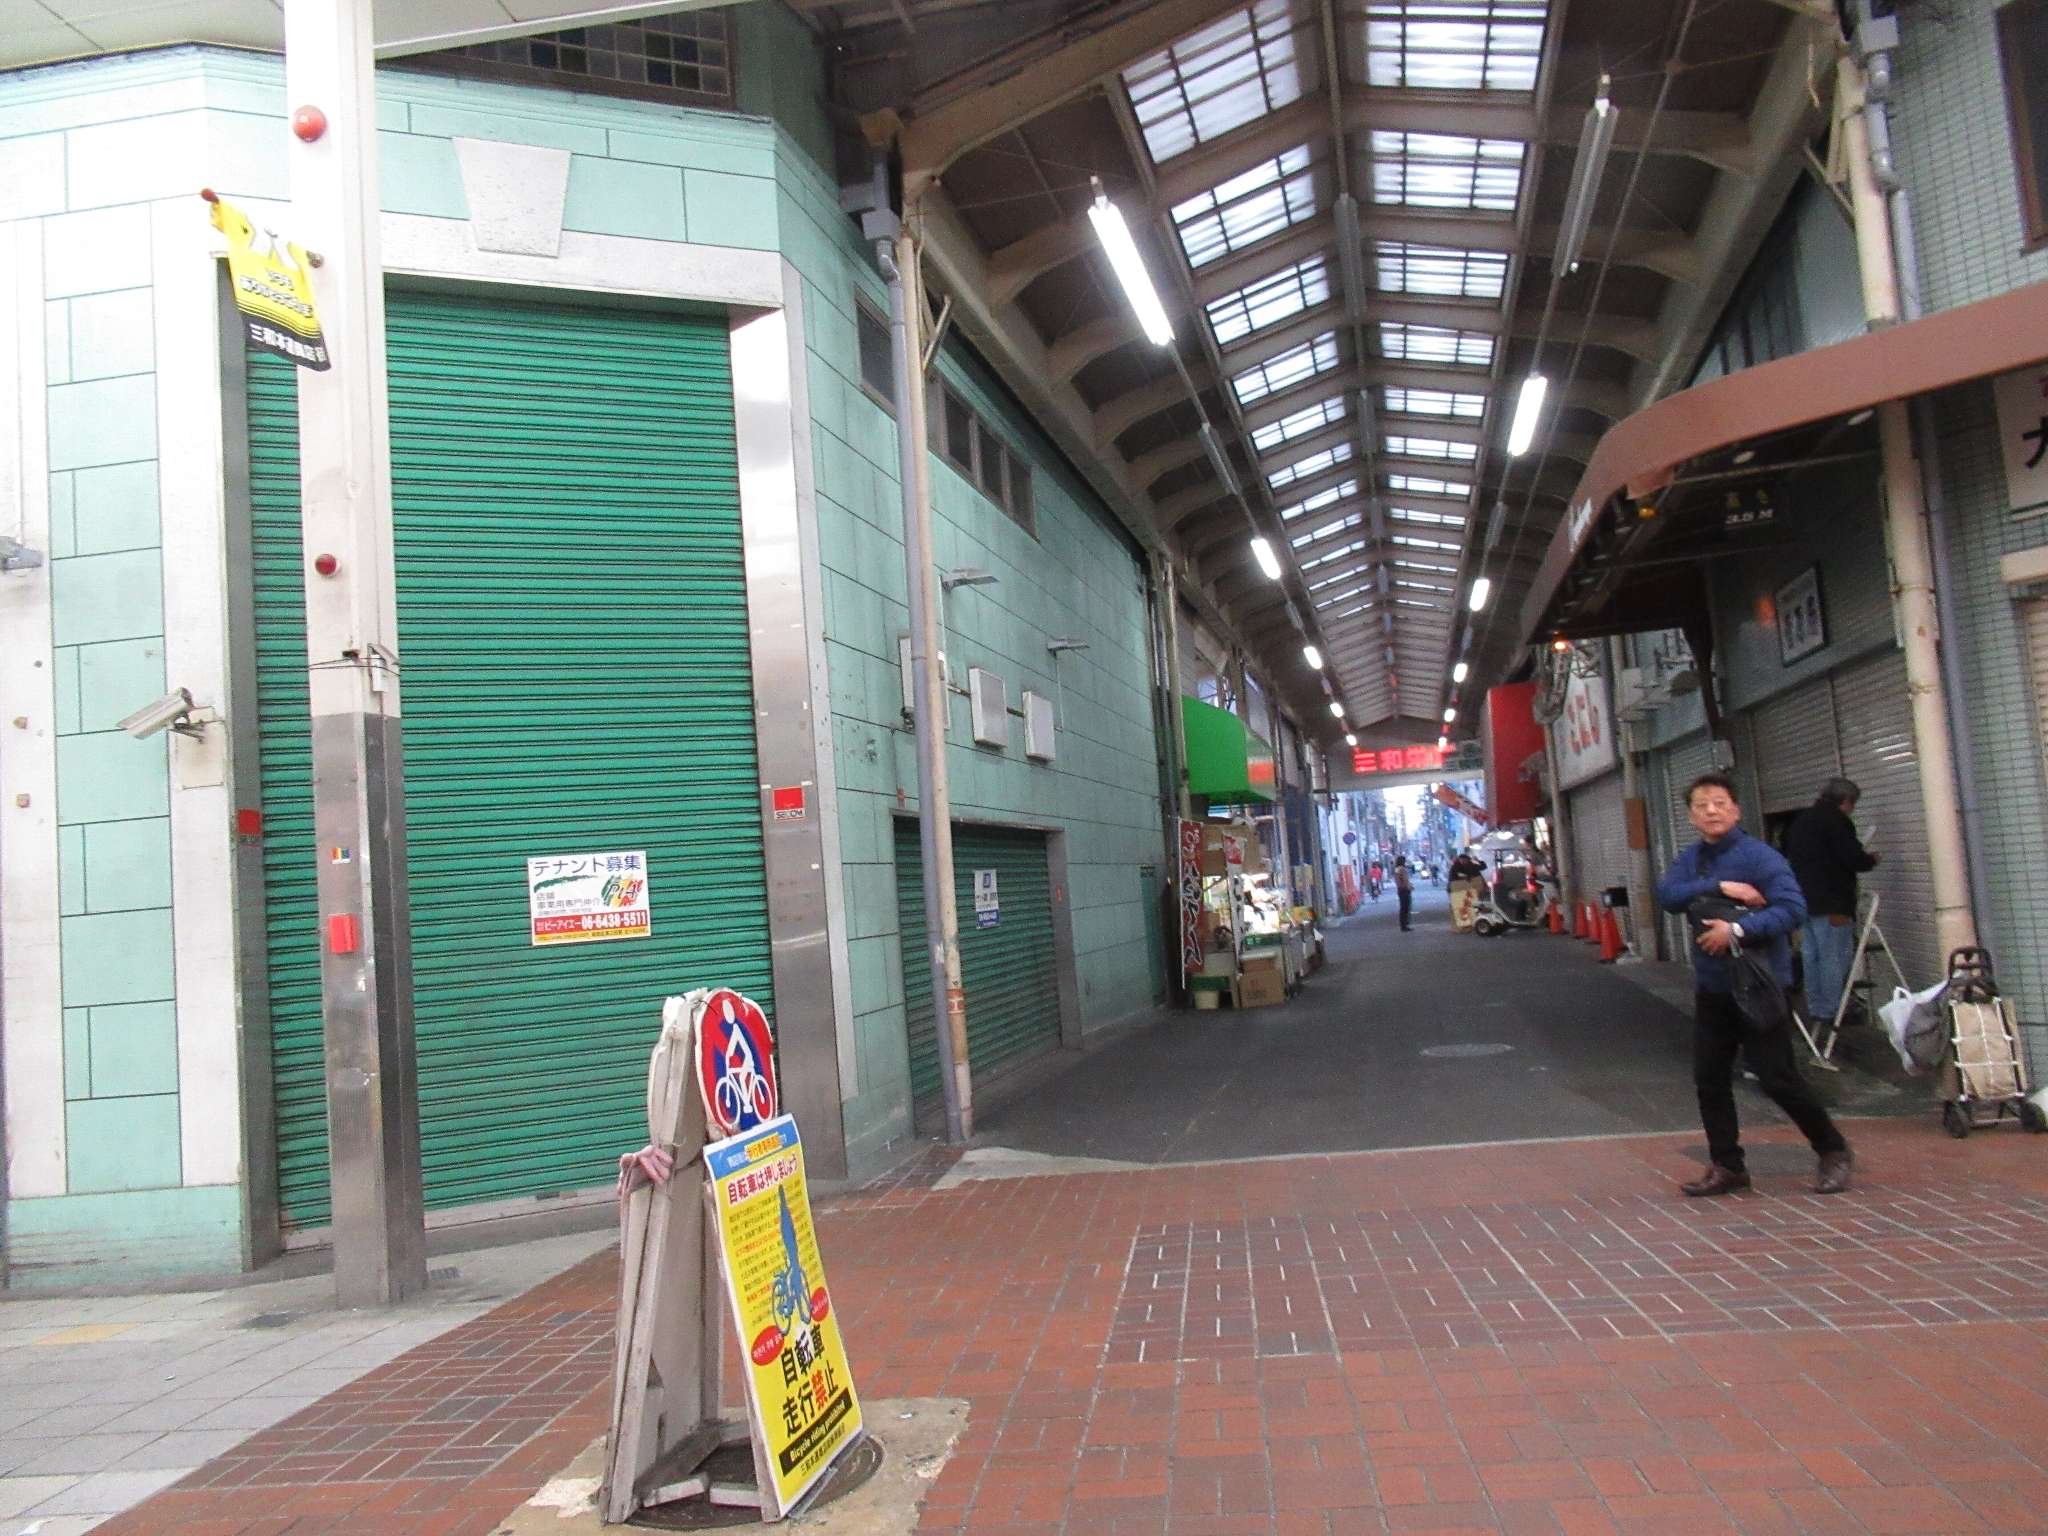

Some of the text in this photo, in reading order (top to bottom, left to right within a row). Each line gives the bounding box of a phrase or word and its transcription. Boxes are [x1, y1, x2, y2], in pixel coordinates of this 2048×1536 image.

[533, 855, 641, 876] テナント募集
[727, 1153, 798, 1206] 自転車は押しましょう
[781, 1324, 825, 1389] 自転車
[782, 1360, 839, 1438] 走行禁止
[790, 1438, 810, 1463] Bicycle
